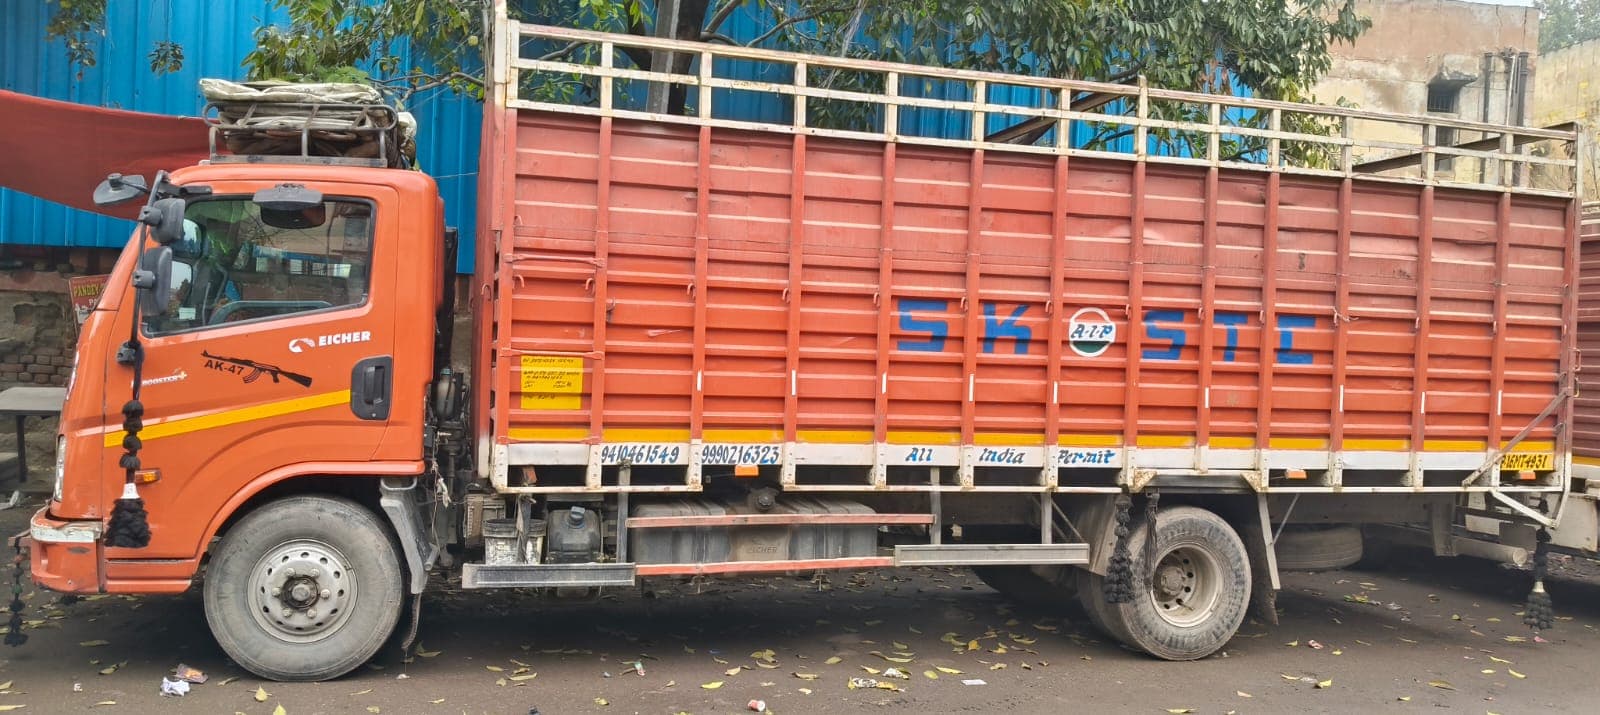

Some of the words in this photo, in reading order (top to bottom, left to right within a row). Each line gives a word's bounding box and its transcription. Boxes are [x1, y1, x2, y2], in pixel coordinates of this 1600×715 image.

[319, 331, 371, 347] EICHER
[204, 360, 244, 375] AK-47
[601, 445, 680, 463] 9410461549
[702, 445, 779, 464] 9990216323
[905, 448, 933, 462] All
[979, 448, 1026, 464] India
[1057, 450, 1116, 464] Permit
